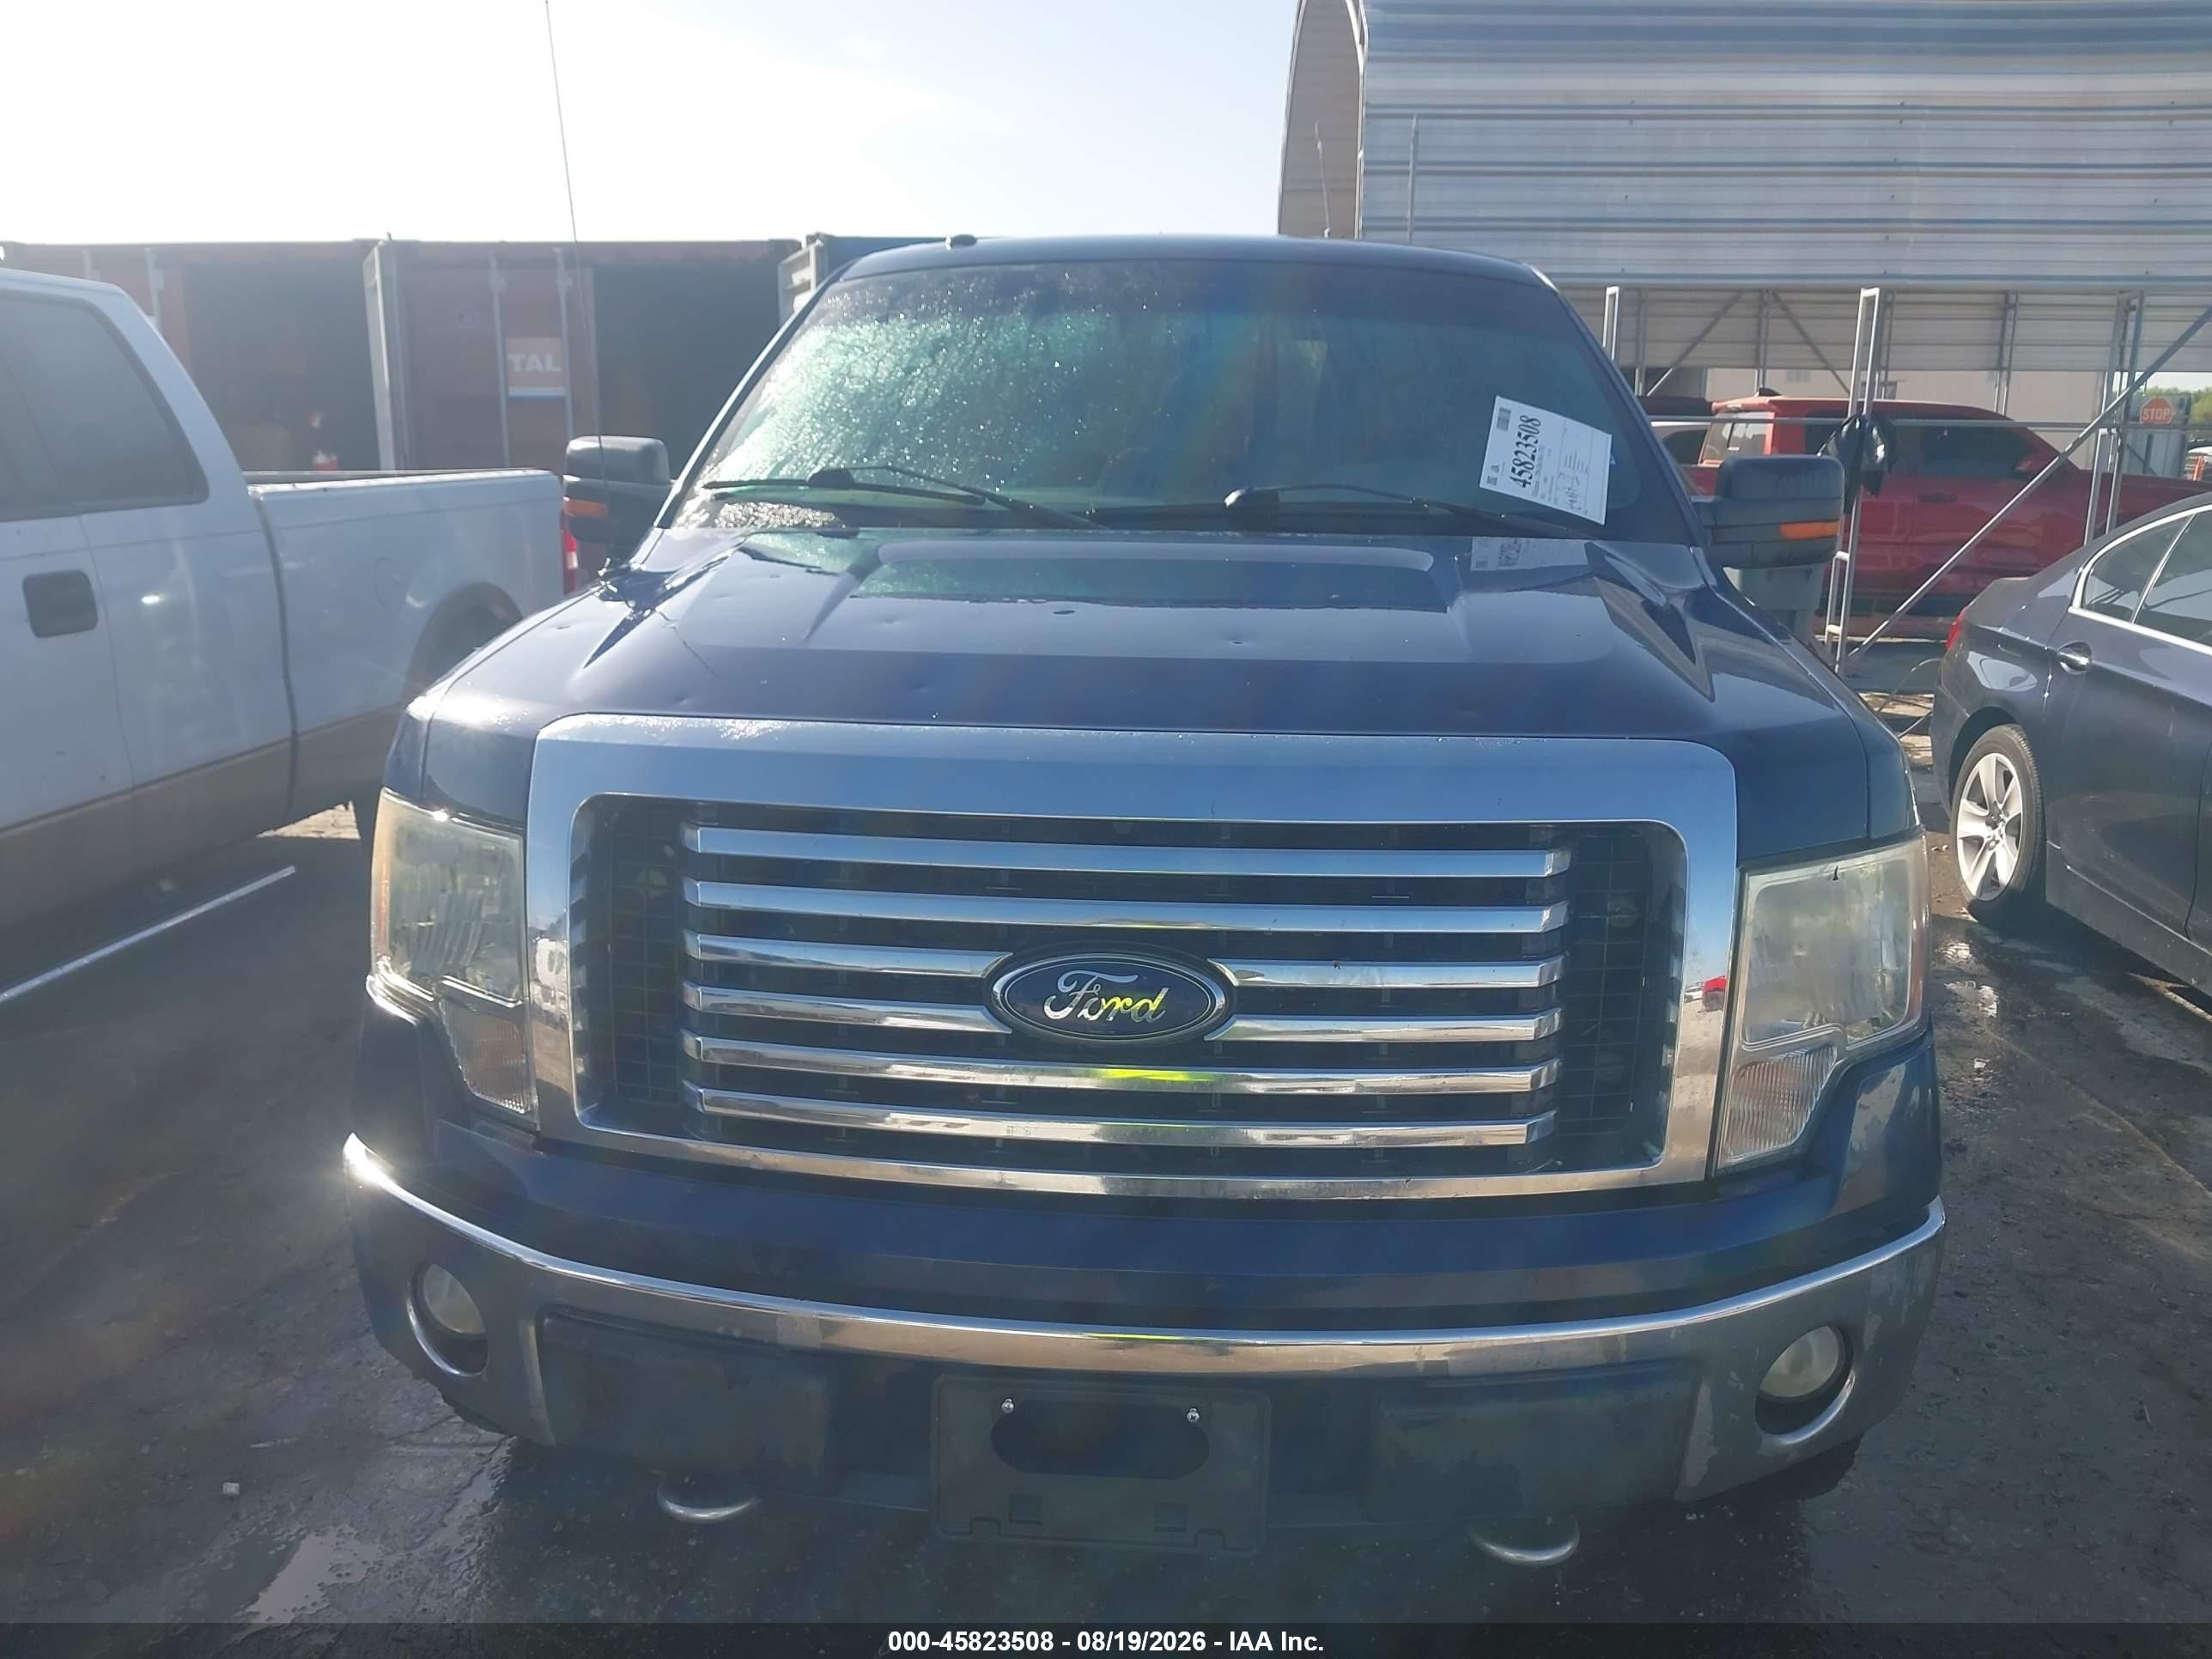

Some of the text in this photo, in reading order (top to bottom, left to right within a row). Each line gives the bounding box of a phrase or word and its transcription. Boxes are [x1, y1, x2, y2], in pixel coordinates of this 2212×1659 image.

[507, 353, 562, 373] TAL
[2142, 407, 2172, 422] STOP
[1509, 415, 1541, 489] 45823508
[1043, 969, 1170, 1022] Ford
